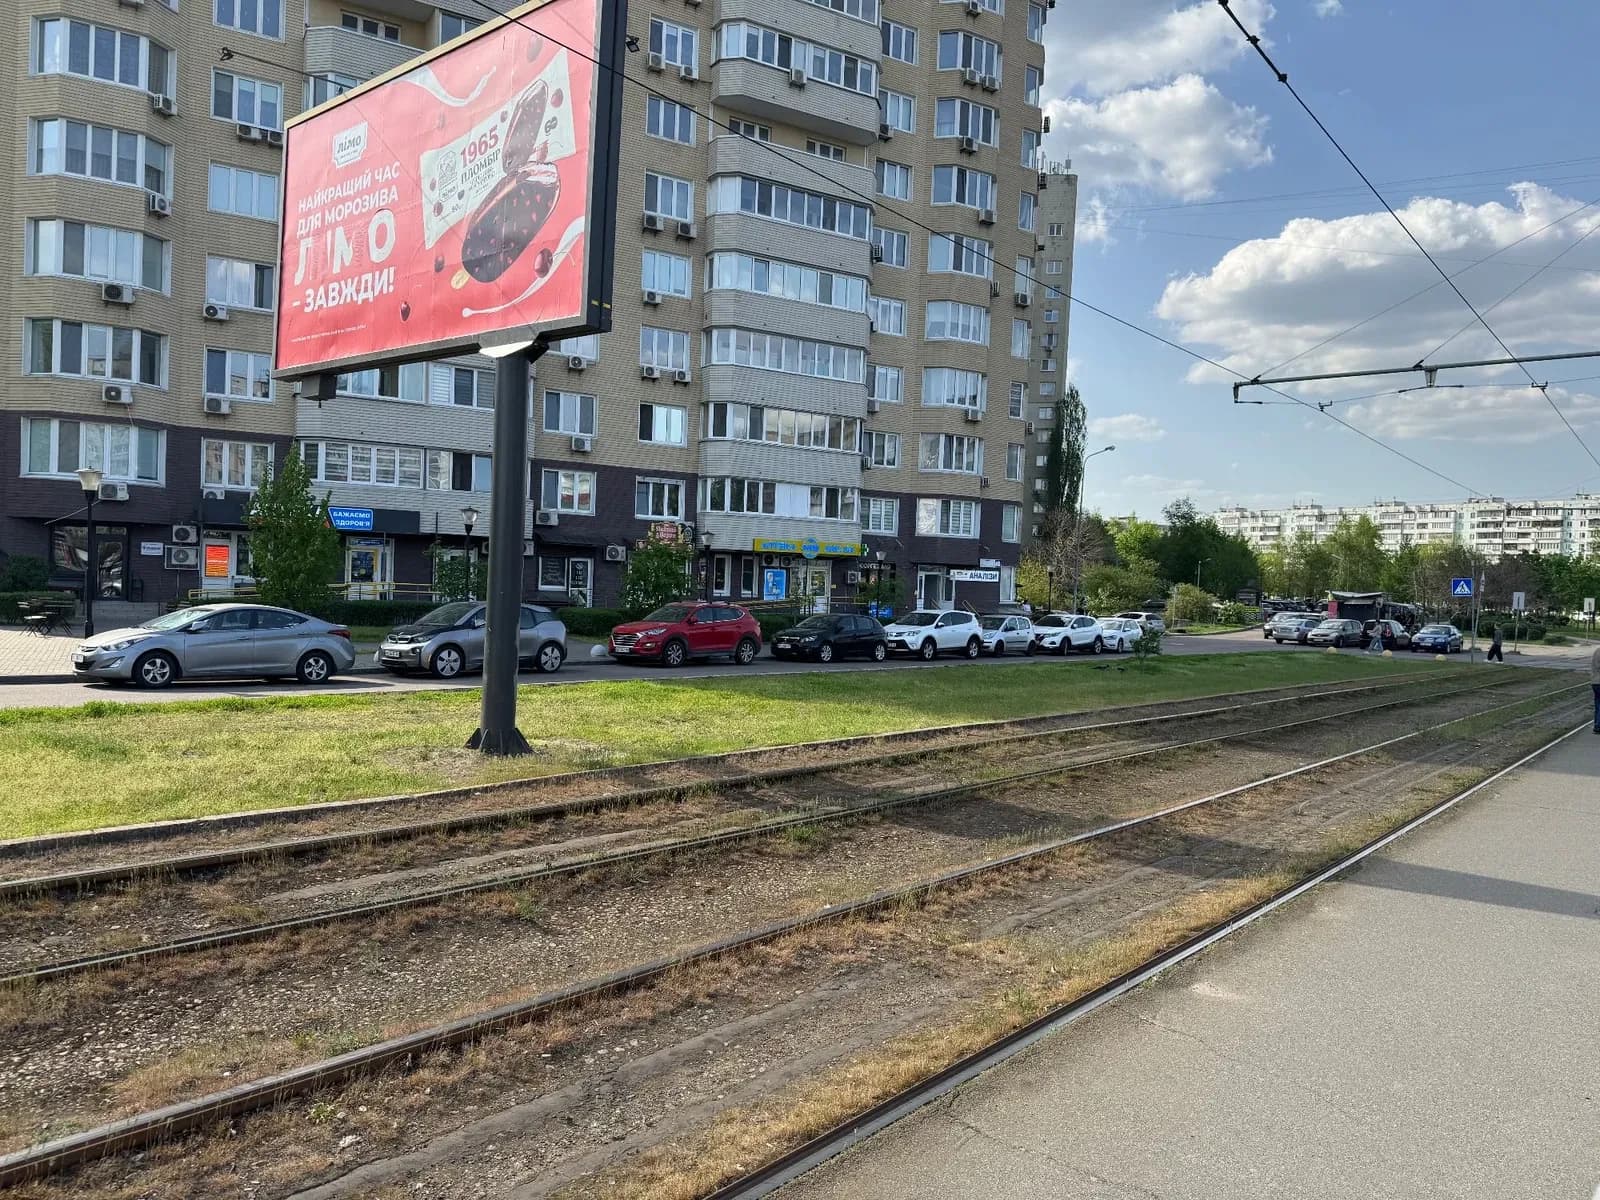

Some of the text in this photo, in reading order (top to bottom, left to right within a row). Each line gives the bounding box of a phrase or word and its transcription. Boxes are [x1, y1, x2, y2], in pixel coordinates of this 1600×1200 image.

[460, 124, 499, 168] 1965
[461, 148, 501, 184] ПЛОМБІР
[299, 161, 400, 213] НАЙКРАЩИЙ ЧАС
[297, 185, 399, 239] ДЛЯ МОРОЗИВА
[304, 267, 396, 313] ЗАВЖДИ!
[969, 571, 998, 580] АНАЛІЗИ
